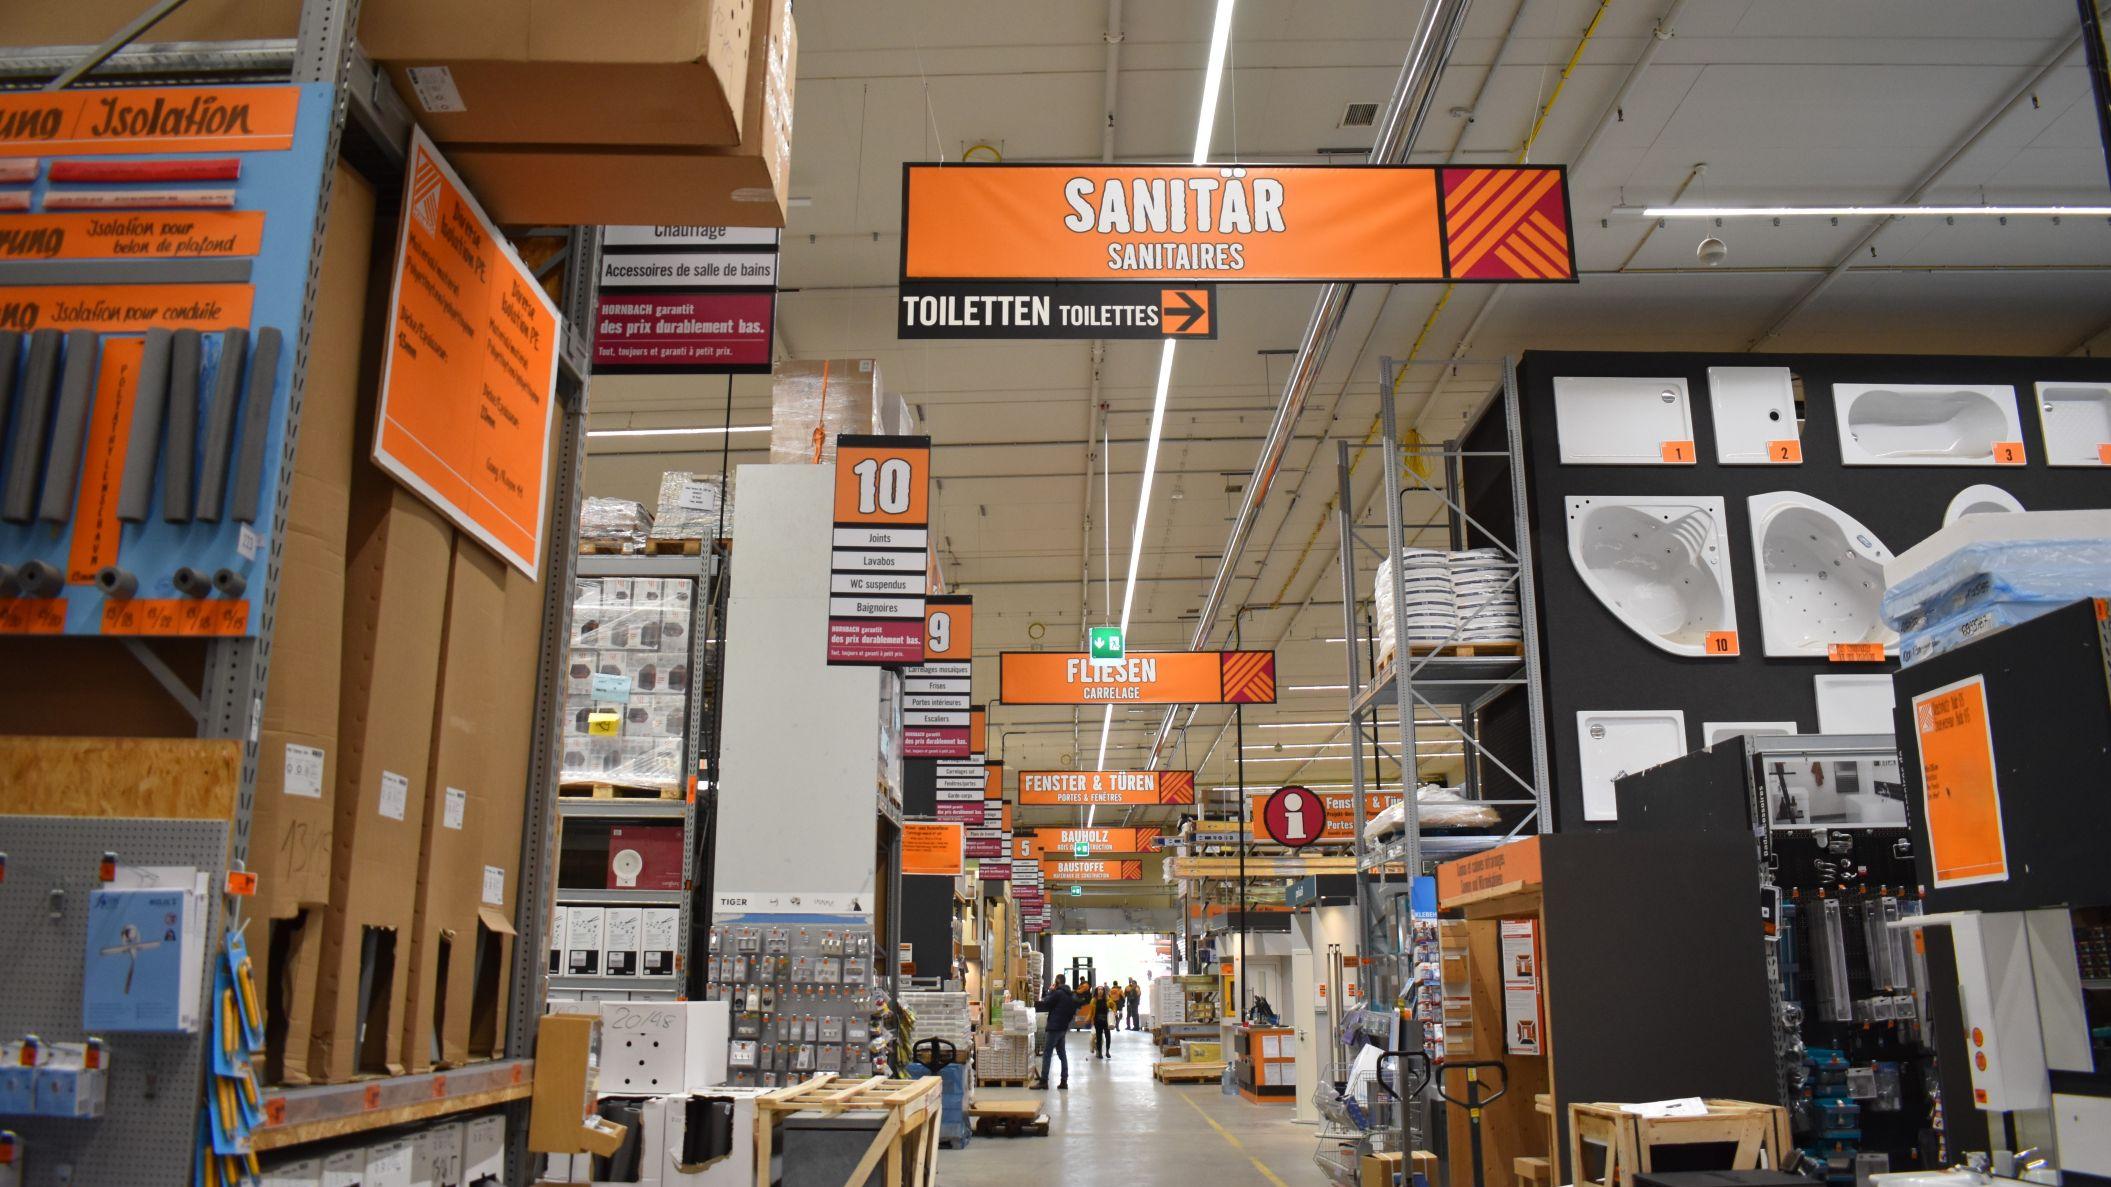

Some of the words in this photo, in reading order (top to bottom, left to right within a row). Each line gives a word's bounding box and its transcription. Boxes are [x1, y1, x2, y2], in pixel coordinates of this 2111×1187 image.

[92, 96, 253, 136] Isolation
[1064, 166, 1286, 234] SANITÄR
[86, 217, 154, 237] Isolation
[160, 222, 195, 236] pour
[156, 239, 173, 253] de
[175, 235, 235, 258] plafond
[1107, 242, 1245, 270] SANITAIRES
[605, 264, 673, 277] Accessoires
[676, 263, 690, 276] de
[694, 263, 720, 276] salle
[723, 263, 737, 276] de
[740, 263, 771, 276] bains
[51, 301, 120, 322] Isolation
[124, 307, 157, 324] pour
[602, 304, 652, 315] HORNBACH
[655, 304, 694, 317] garantit
[902, 296, 1049, 326] TOILETTEN
[1059, 305, 1159, 326] TOILETTES
[600, 320, 622, 334] des
[626, 319, 651, 336] prix
[656, 319, 734, 334] durablement
[738, 319, 765, 333] bas.
[598, 347, 616, 356] Tout,
[618, 347, 648, 357] toujours
[650, 347, 658, 356] et
[660, 347, 687, 357] garanti
[689, 347, 694, 356] à
[695, 347, 714, 357] petit
[716, 347, 733, 357] prix.
[1675, 447, 1682, 460] 1
[1781, 447, 1789, 460] 2
[2005, 449, 2013, 462] 3
[853, 457, 912, 515] 10
[869, 534, 892, 544] Joints
[863, 556, 895, 566] Lavabos
[850, 578, 864, 589] WC
[866, 580, 906, 591] suspendus
[856, 602, 898, 614] Baignoires
[928, 611, 950, 653] 9
[831, 634, 843, 643] des
[846, 635, 859, 645] prix
[862, 635, 904, 644] durablement
[906, 636, 921, 645] bas.
[1716, 638, 1728, 652] 10
[1067, 658, 1157, 683] FLIESEN
[1083, 687, 1140, 699] CARRELAGE
[932, 698, 961, 706] intérieures
[1025, 775, 1086, 791] FENSTER
[1092, 775, 1102, 791] &
[1110, 772, 1154, 791] TÜREN
[1058, 793, 1081, 801] PORTES
[1091, 792, 1122, 801] FENÊTRES
[1327, 820, 1353, 829] Portes
[1061, 830, 1109, 843] BAUHOLZ
[1021, 840, 1030, 856] 5
[1058, 862, 1104, 872] BAUSTOFFE
[721, 898, 747, 906] TIGER
